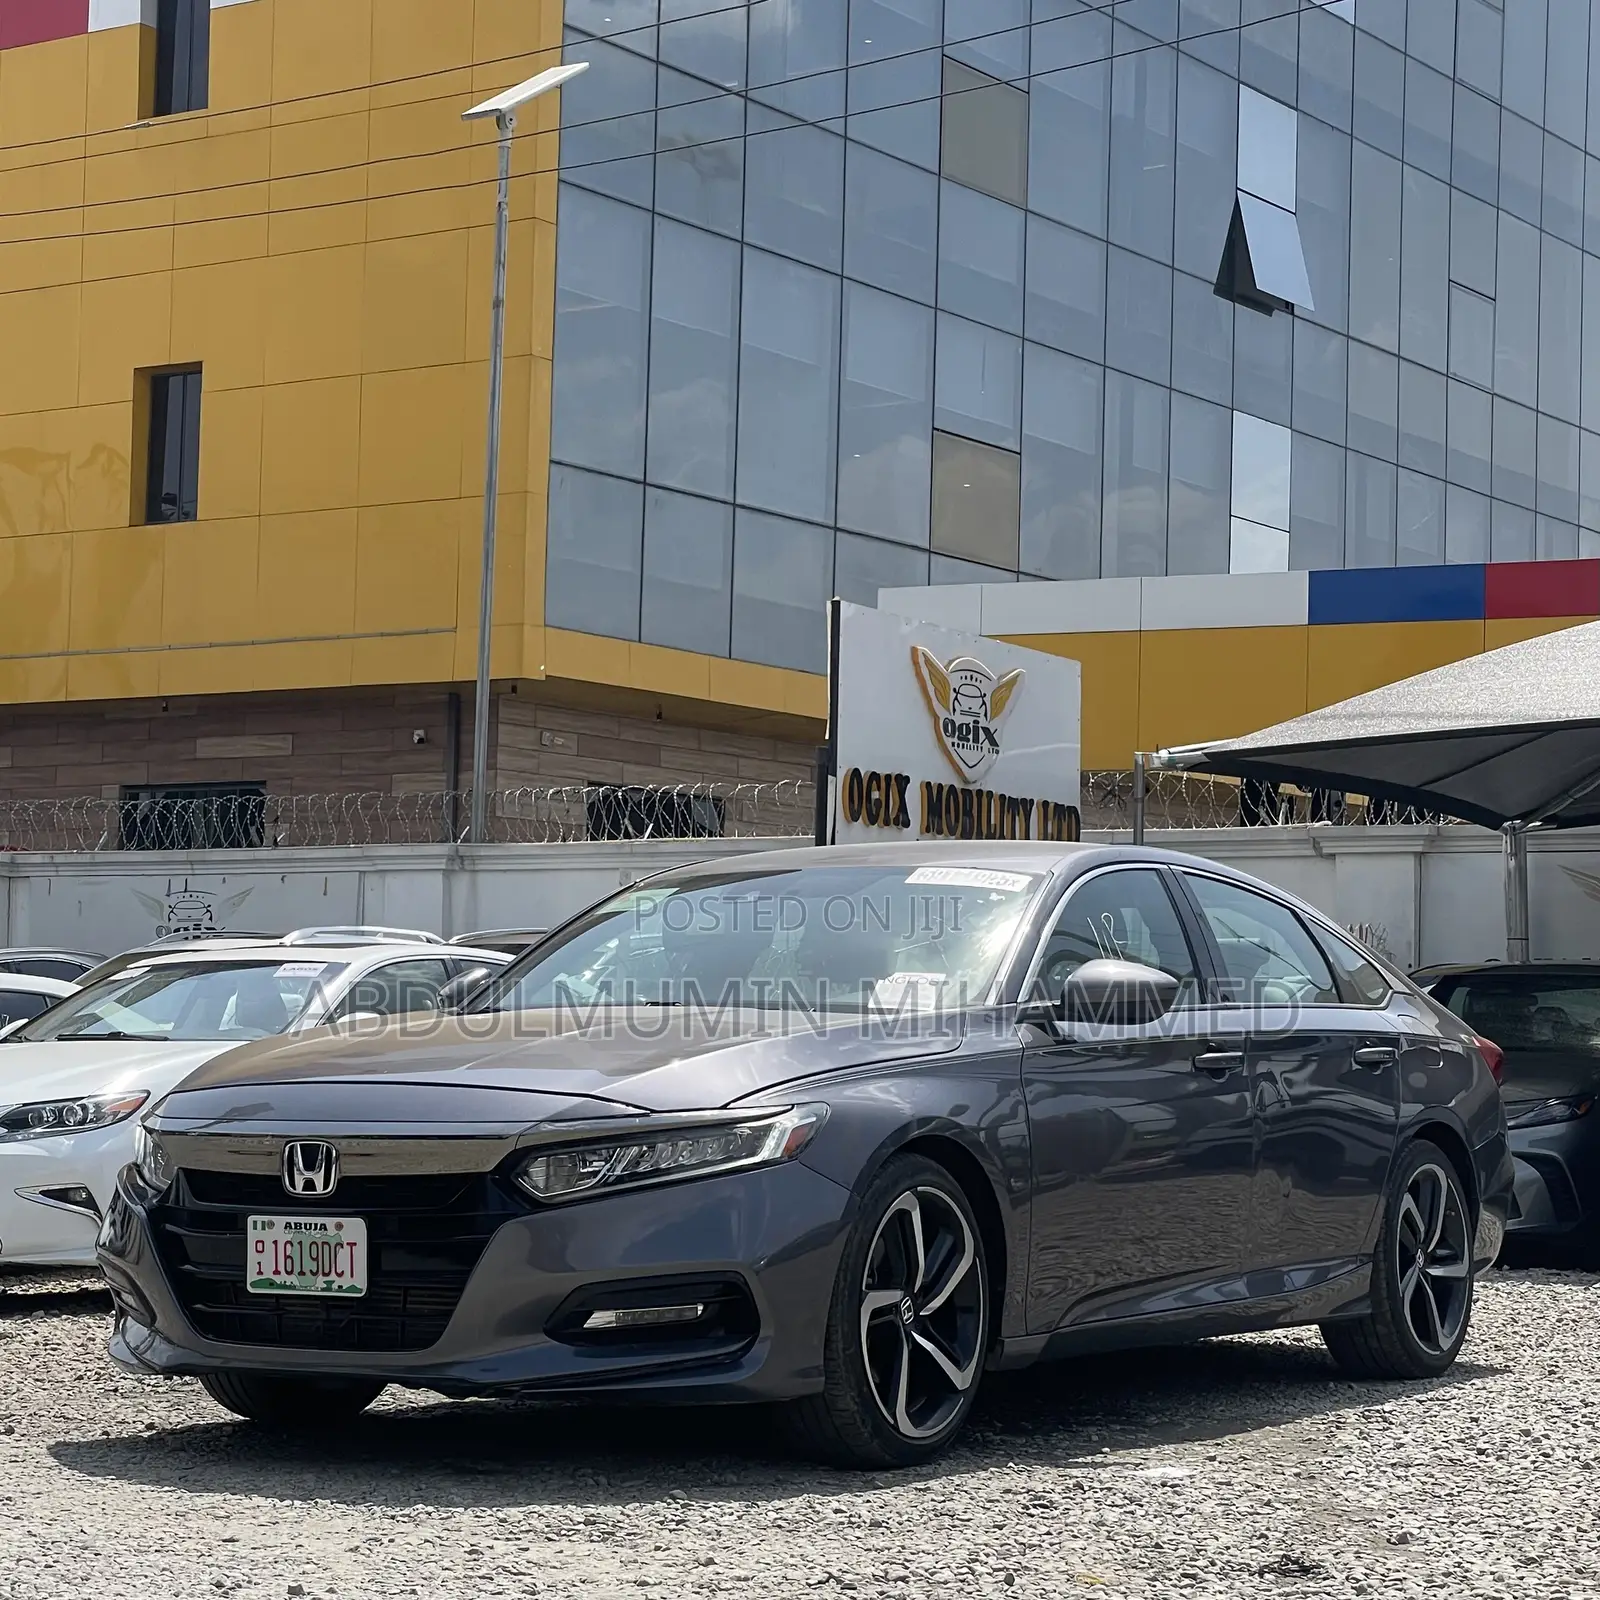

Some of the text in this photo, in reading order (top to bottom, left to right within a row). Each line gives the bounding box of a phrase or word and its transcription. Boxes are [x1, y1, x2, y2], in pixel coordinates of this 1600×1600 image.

[842, 767, 1081, 842] OGIX MOBILITY LTD
[283, 1221, 328, 1231] ABUJA
[272, 1239, 357, 1279] 1619DCT
